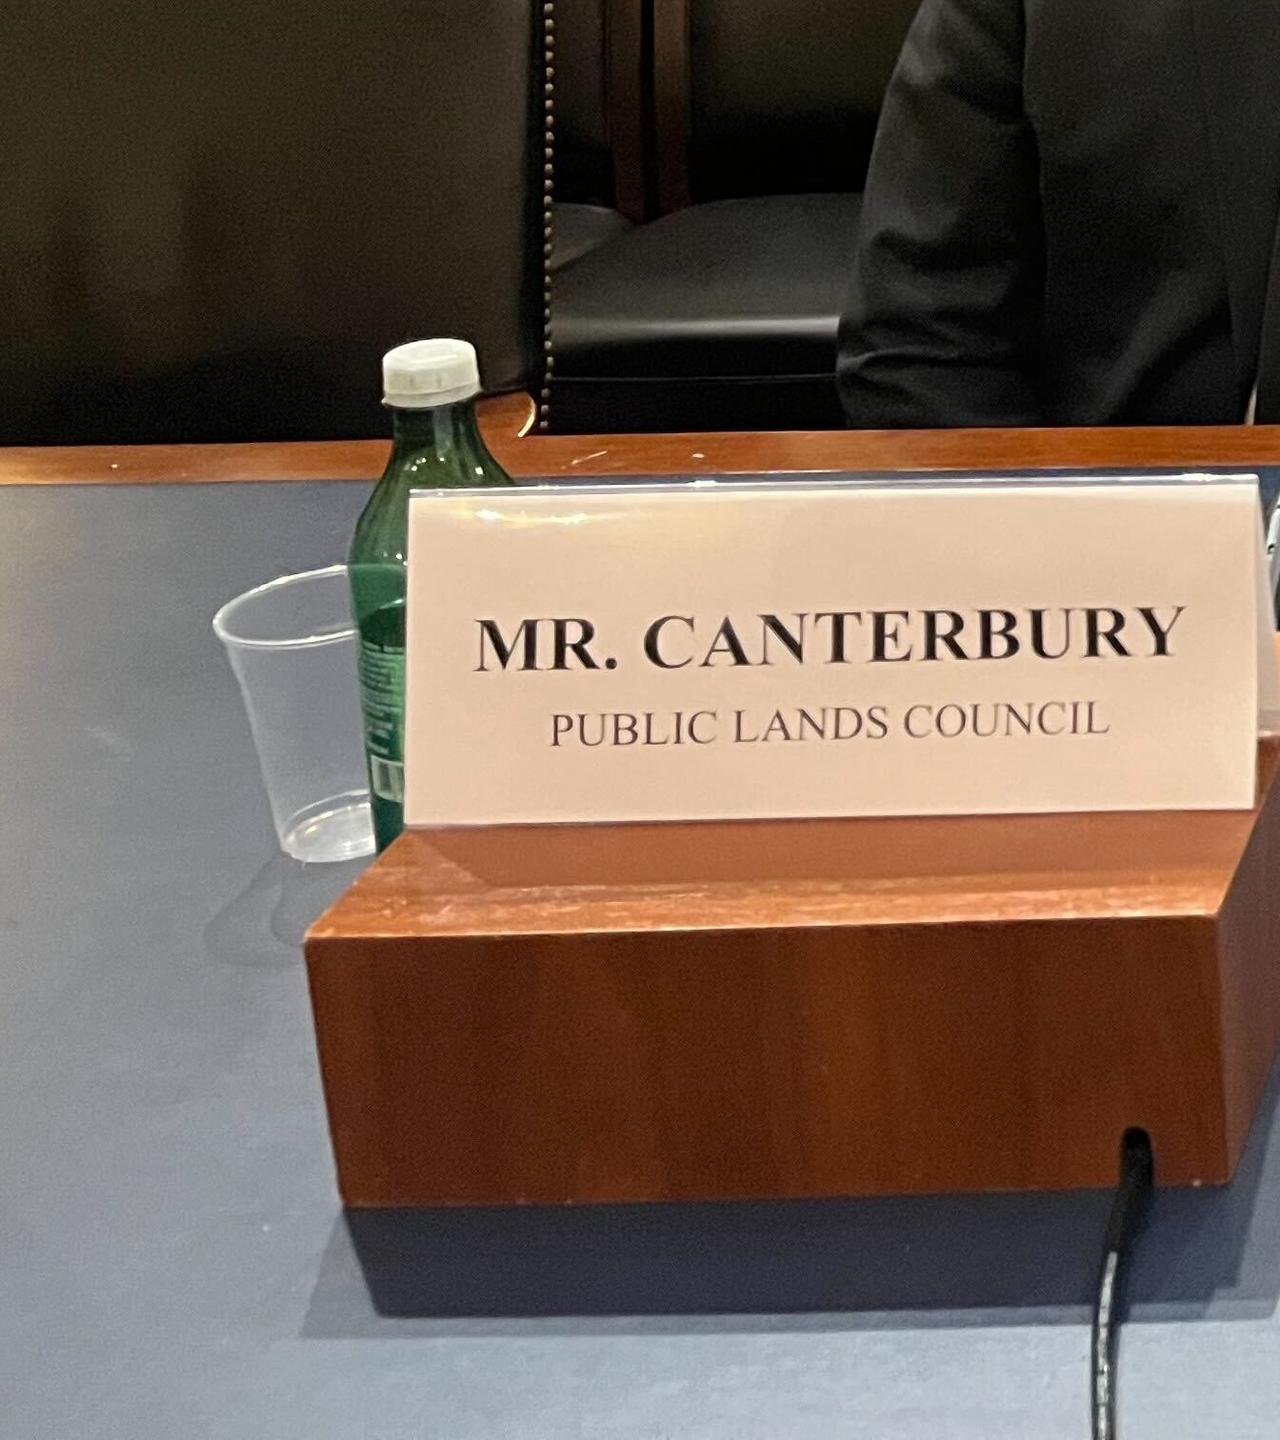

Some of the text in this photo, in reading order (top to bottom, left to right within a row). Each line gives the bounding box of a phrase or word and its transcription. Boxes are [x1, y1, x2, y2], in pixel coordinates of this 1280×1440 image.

[473, 604, 1186, 672] MR. CANTERBURY
[551, 701, 1110, 747] PUBLIC LANDS COUNCIL
